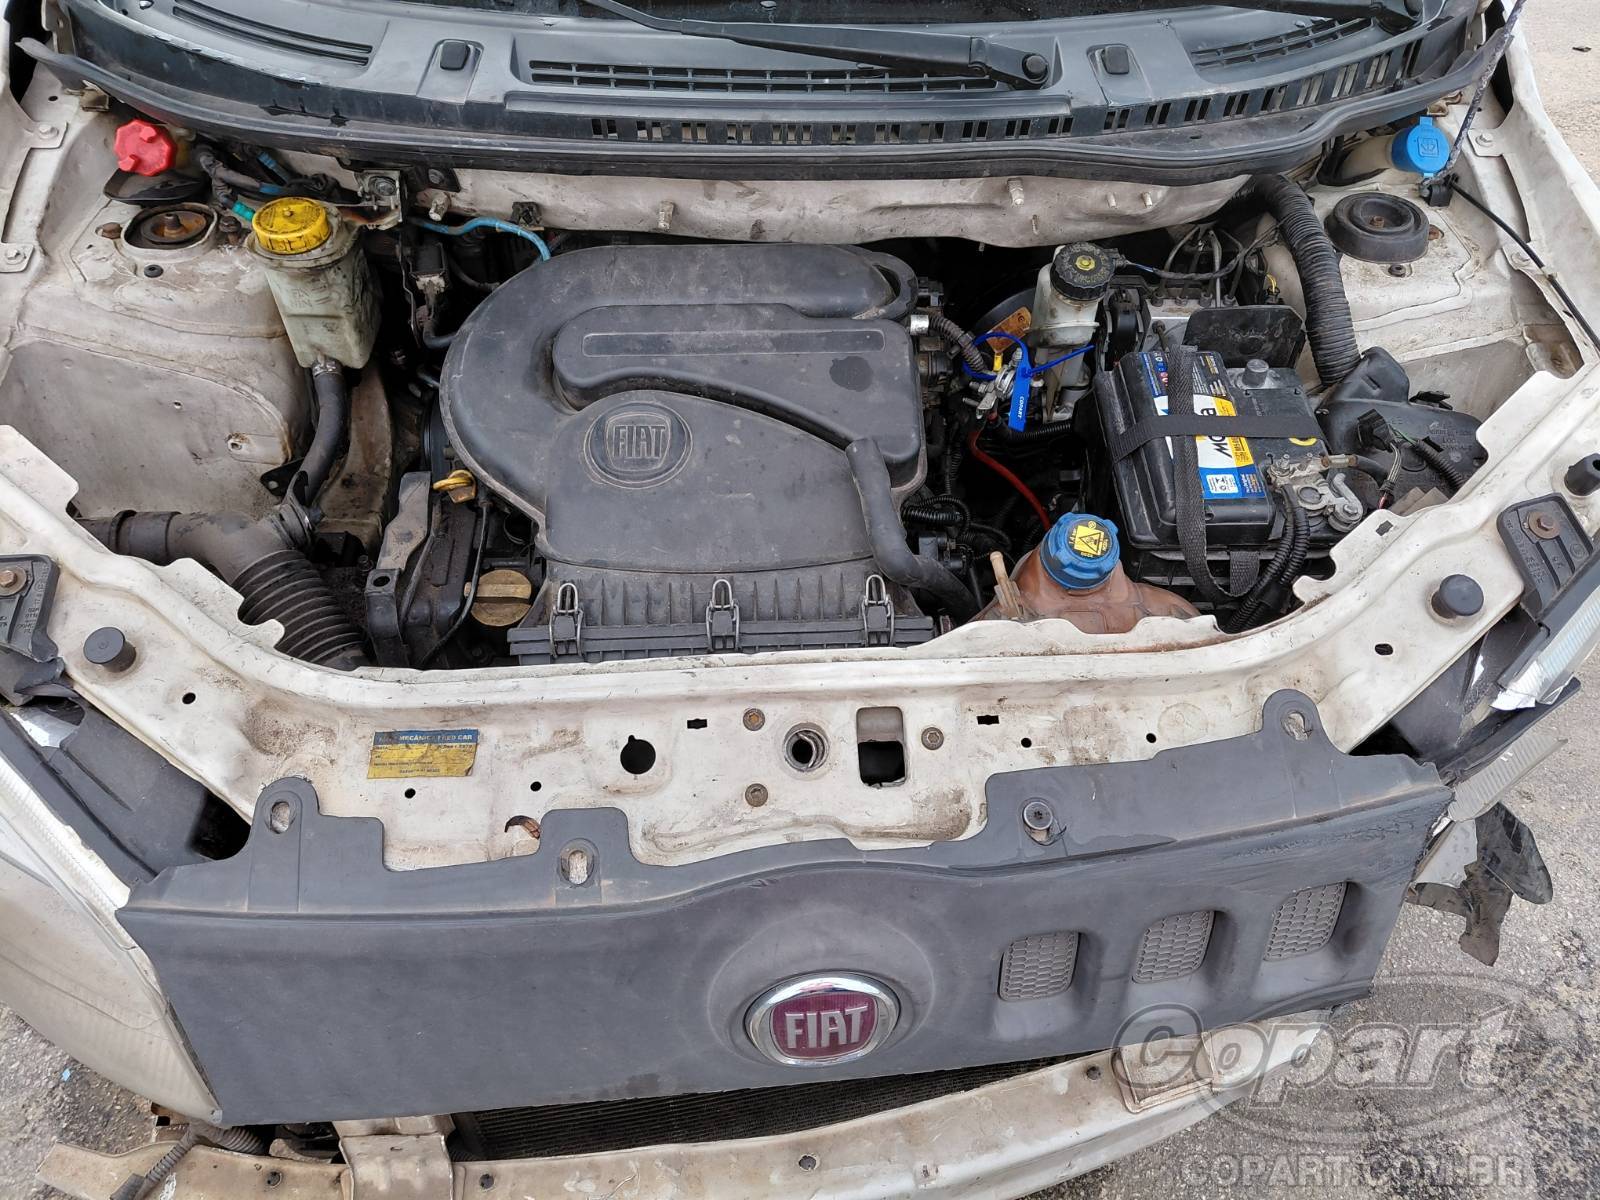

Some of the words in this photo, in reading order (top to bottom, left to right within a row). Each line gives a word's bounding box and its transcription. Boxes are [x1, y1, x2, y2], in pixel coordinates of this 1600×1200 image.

[1017, 395, 1025, 420] COPART
[613, 424, 666, 459] FIAT
[784, 1002, 869, 1049] FIAT
